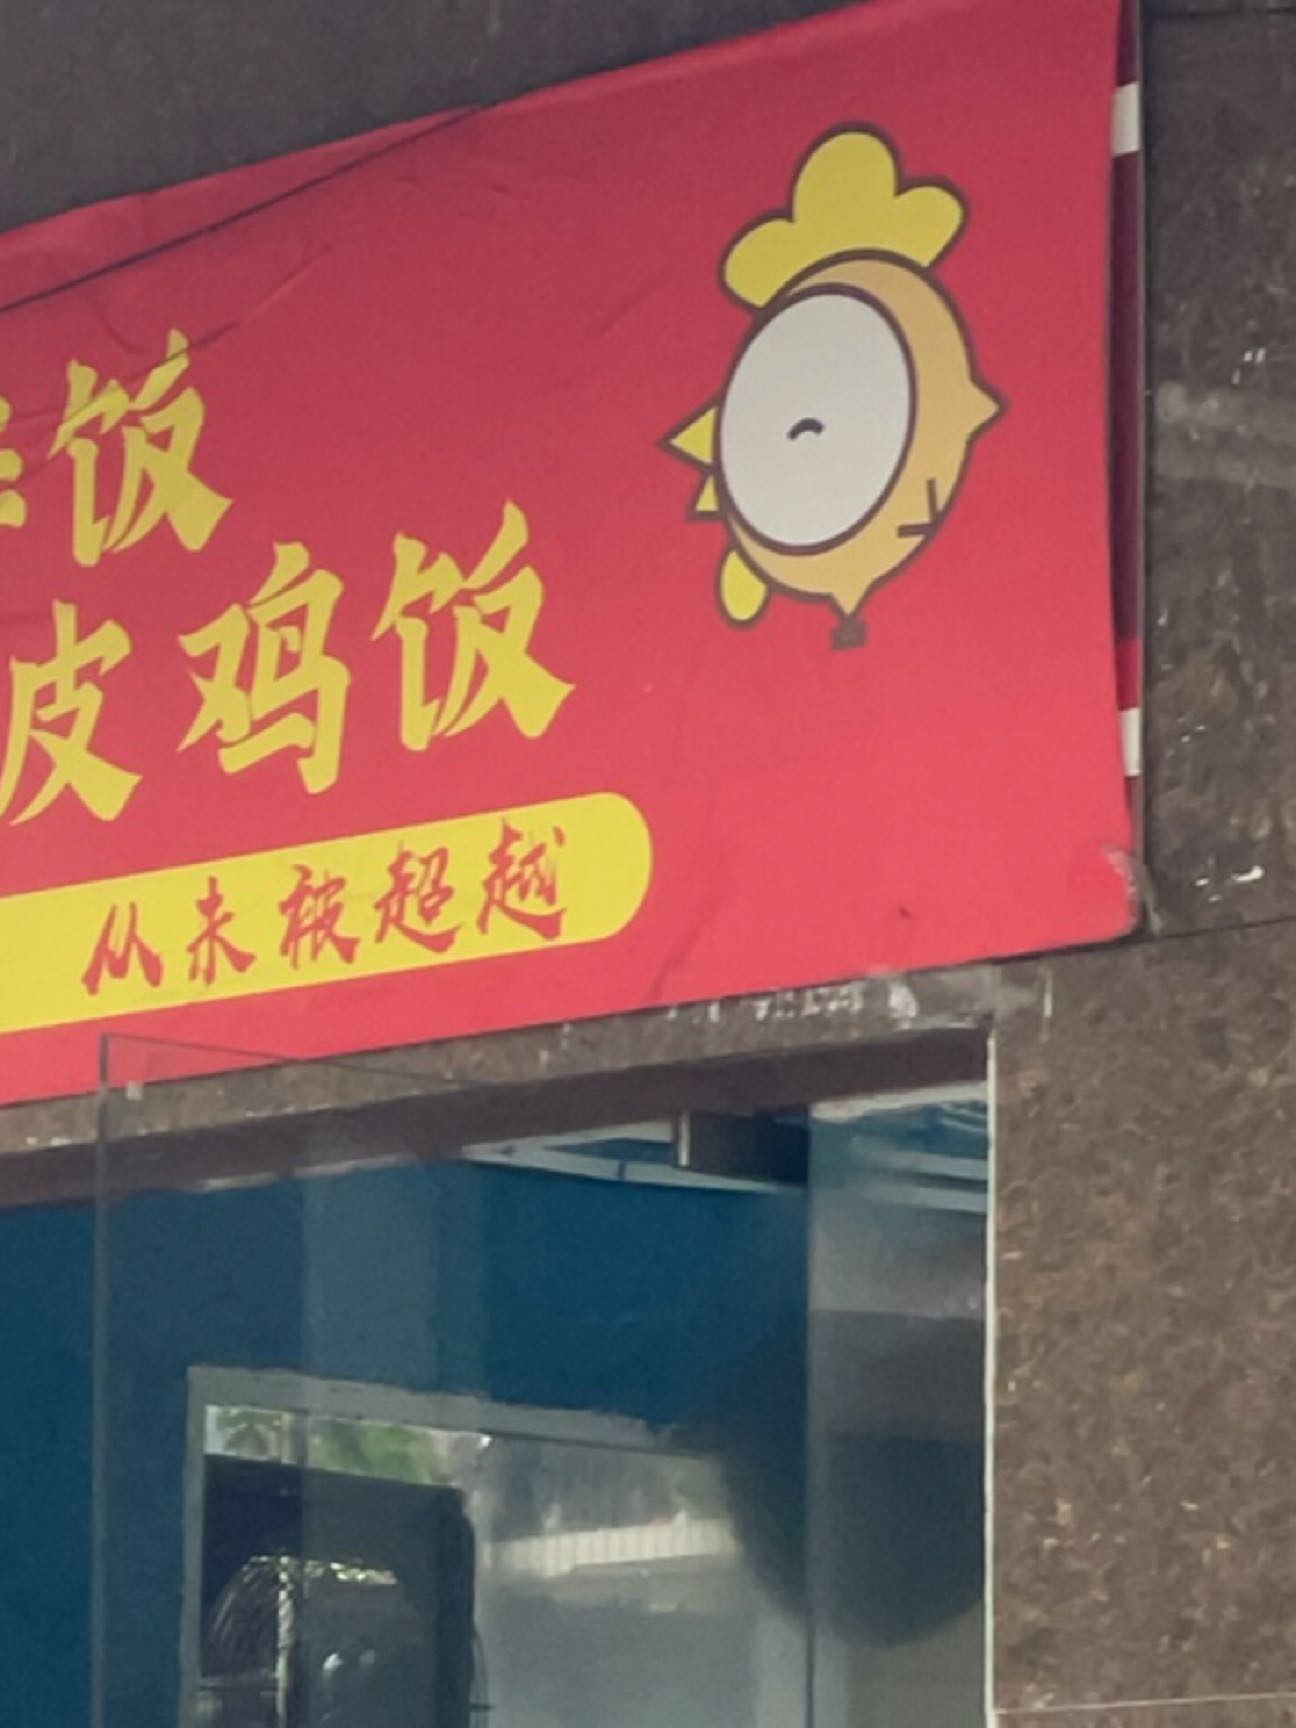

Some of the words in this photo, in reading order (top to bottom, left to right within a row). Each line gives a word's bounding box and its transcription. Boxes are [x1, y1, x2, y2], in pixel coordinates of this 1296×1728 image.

[80, 818, 568, 996] 从未被超越
